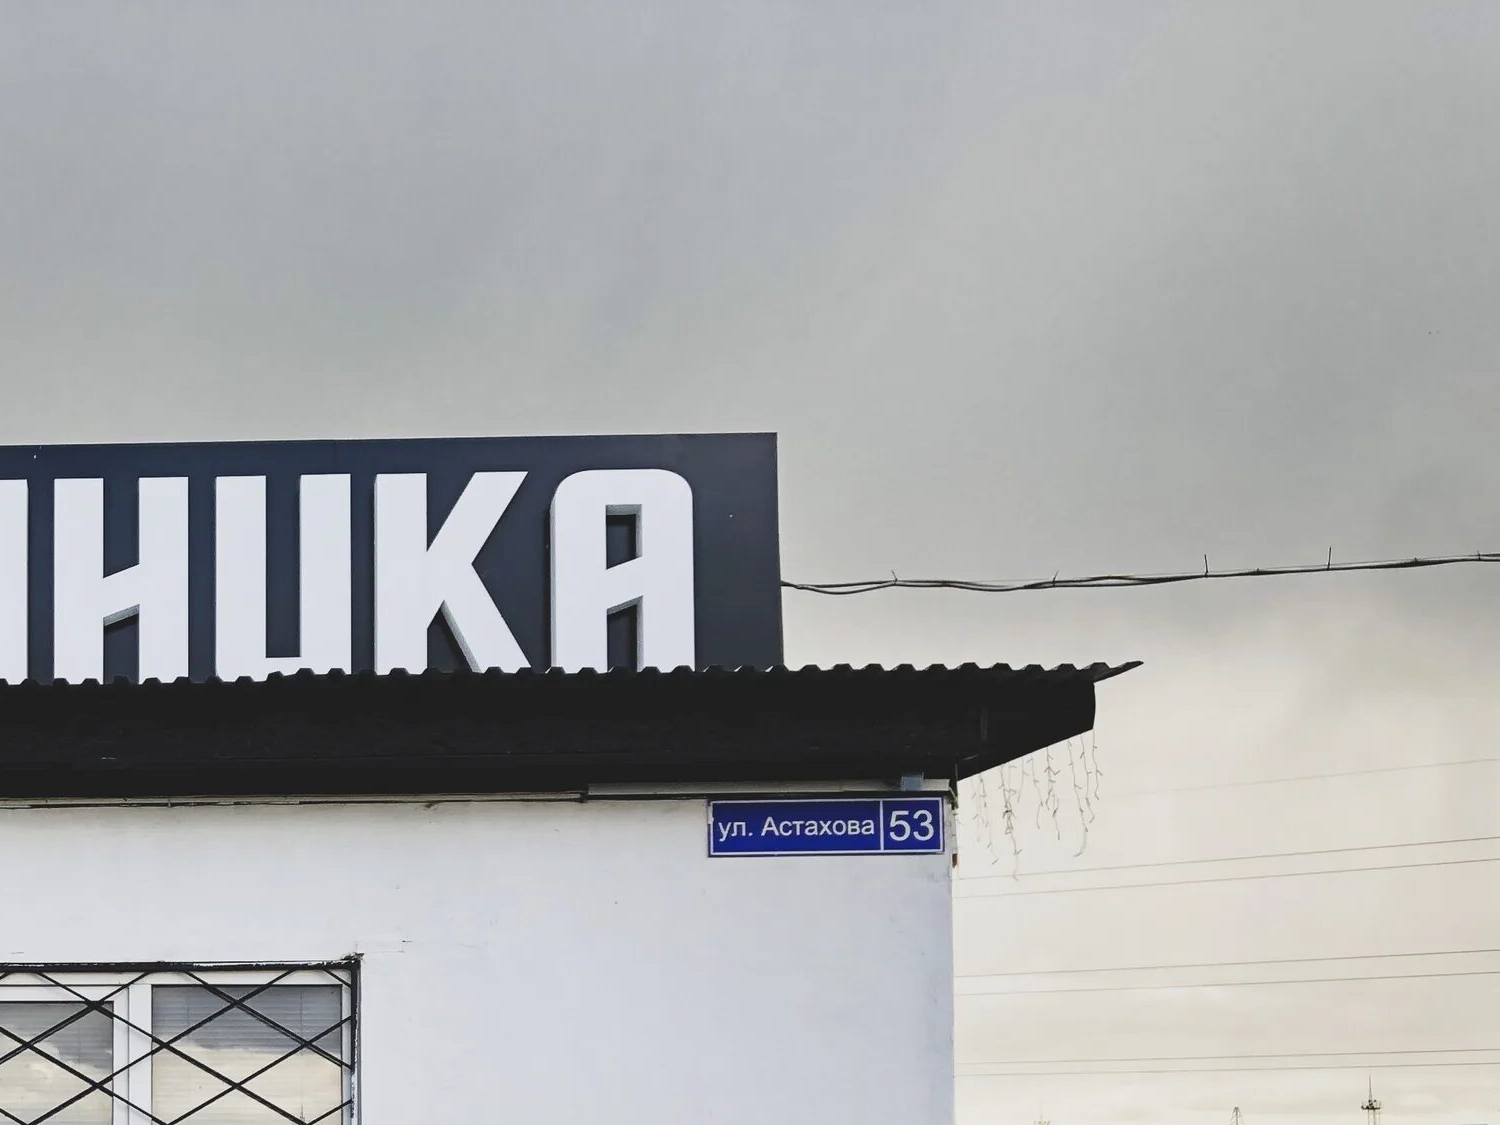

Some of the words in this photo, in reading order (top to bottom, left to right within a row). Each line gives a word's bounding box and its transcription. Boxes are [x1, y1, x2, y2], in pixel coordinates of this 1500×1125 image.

[718, 821, 753, 842] ул.
[761, 816, 875, 837] Астахова
[889, 809, 935, 842] 53
